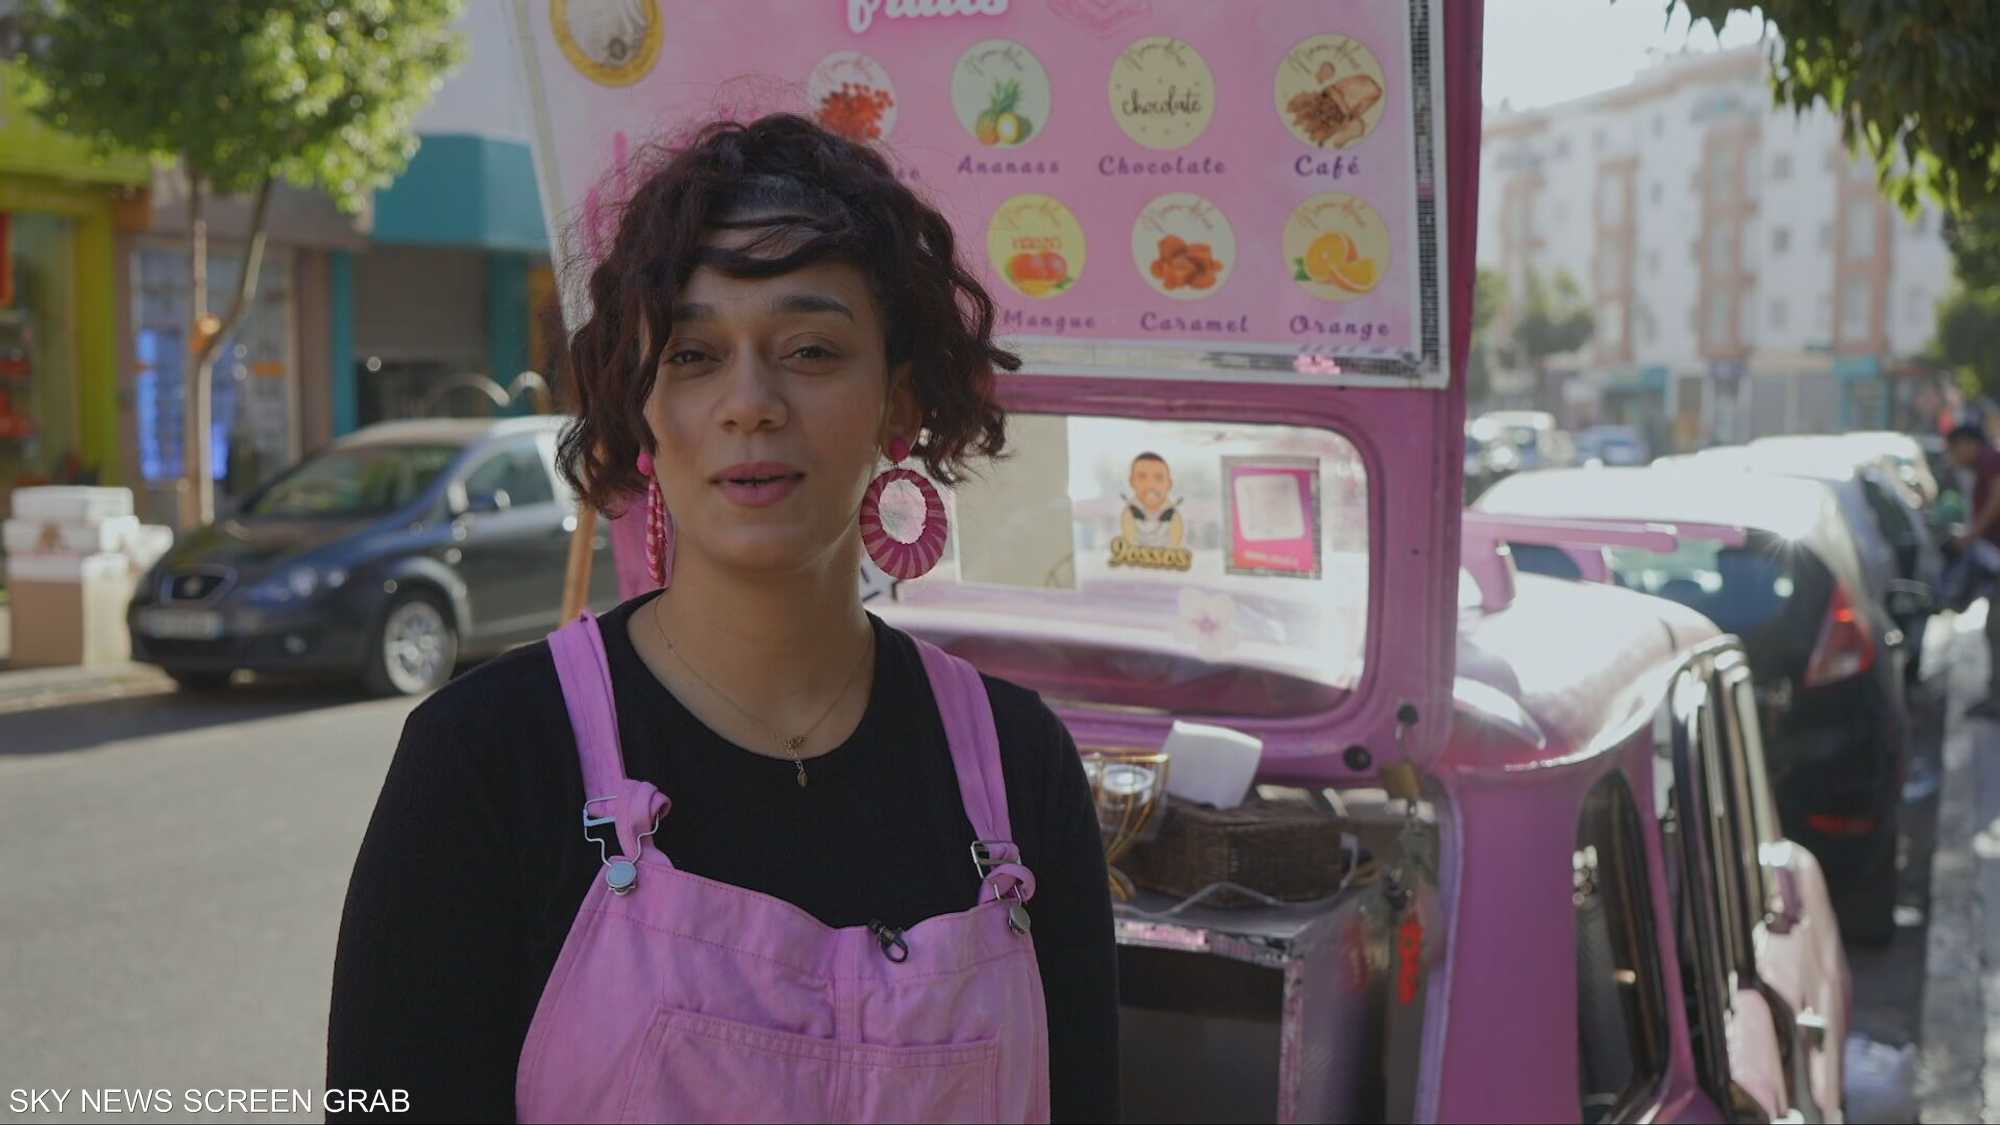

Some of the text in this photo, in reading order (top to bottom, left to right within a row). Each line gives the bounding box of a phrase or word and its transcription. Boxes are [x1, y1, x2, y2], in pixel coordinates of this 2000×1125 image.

[1121, 85, 1202, 116] chocolate
[1098, 154, 1226, 176] Chocolate
[1294, 154, 1361, 180] Café
[1003, 309, 1096, 334] Mangue
[1140, 311, 1249, 334] Caramel
[1289, 314, 1391, 341] Orange
